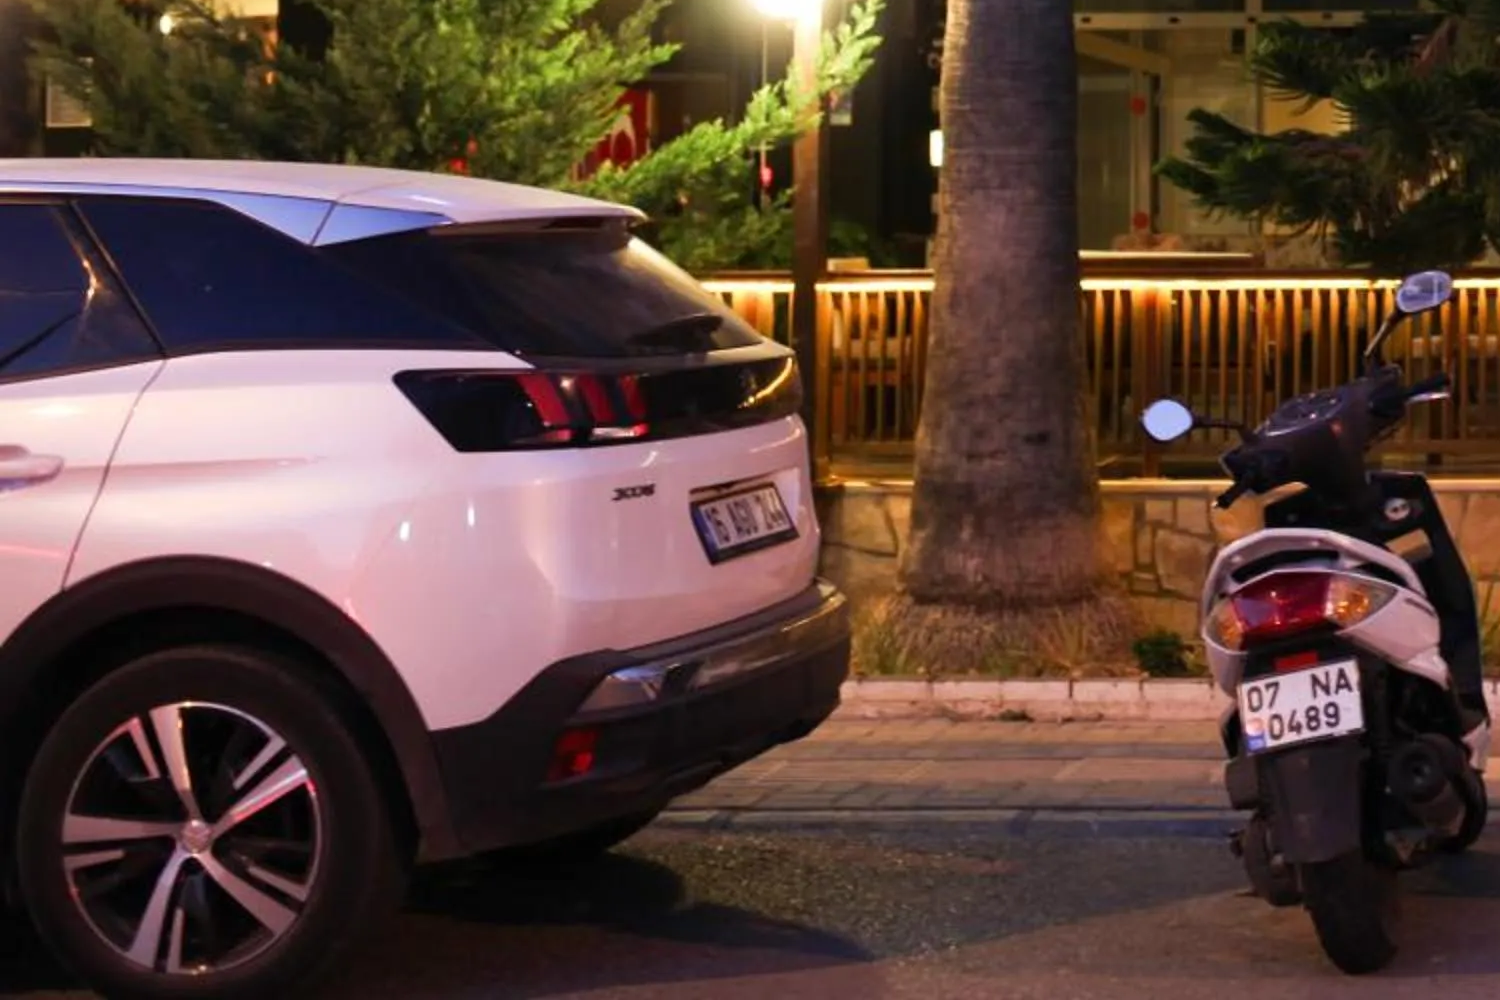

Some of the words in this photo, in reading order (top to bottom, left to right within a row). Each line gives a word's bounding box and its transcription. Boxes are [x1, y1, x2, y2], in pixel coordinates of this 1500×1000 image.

[1247, 681, 1280, 713] 07
[1311, 667, 1353, 700] NA
[1269, 702, 1340, 740] 0489
